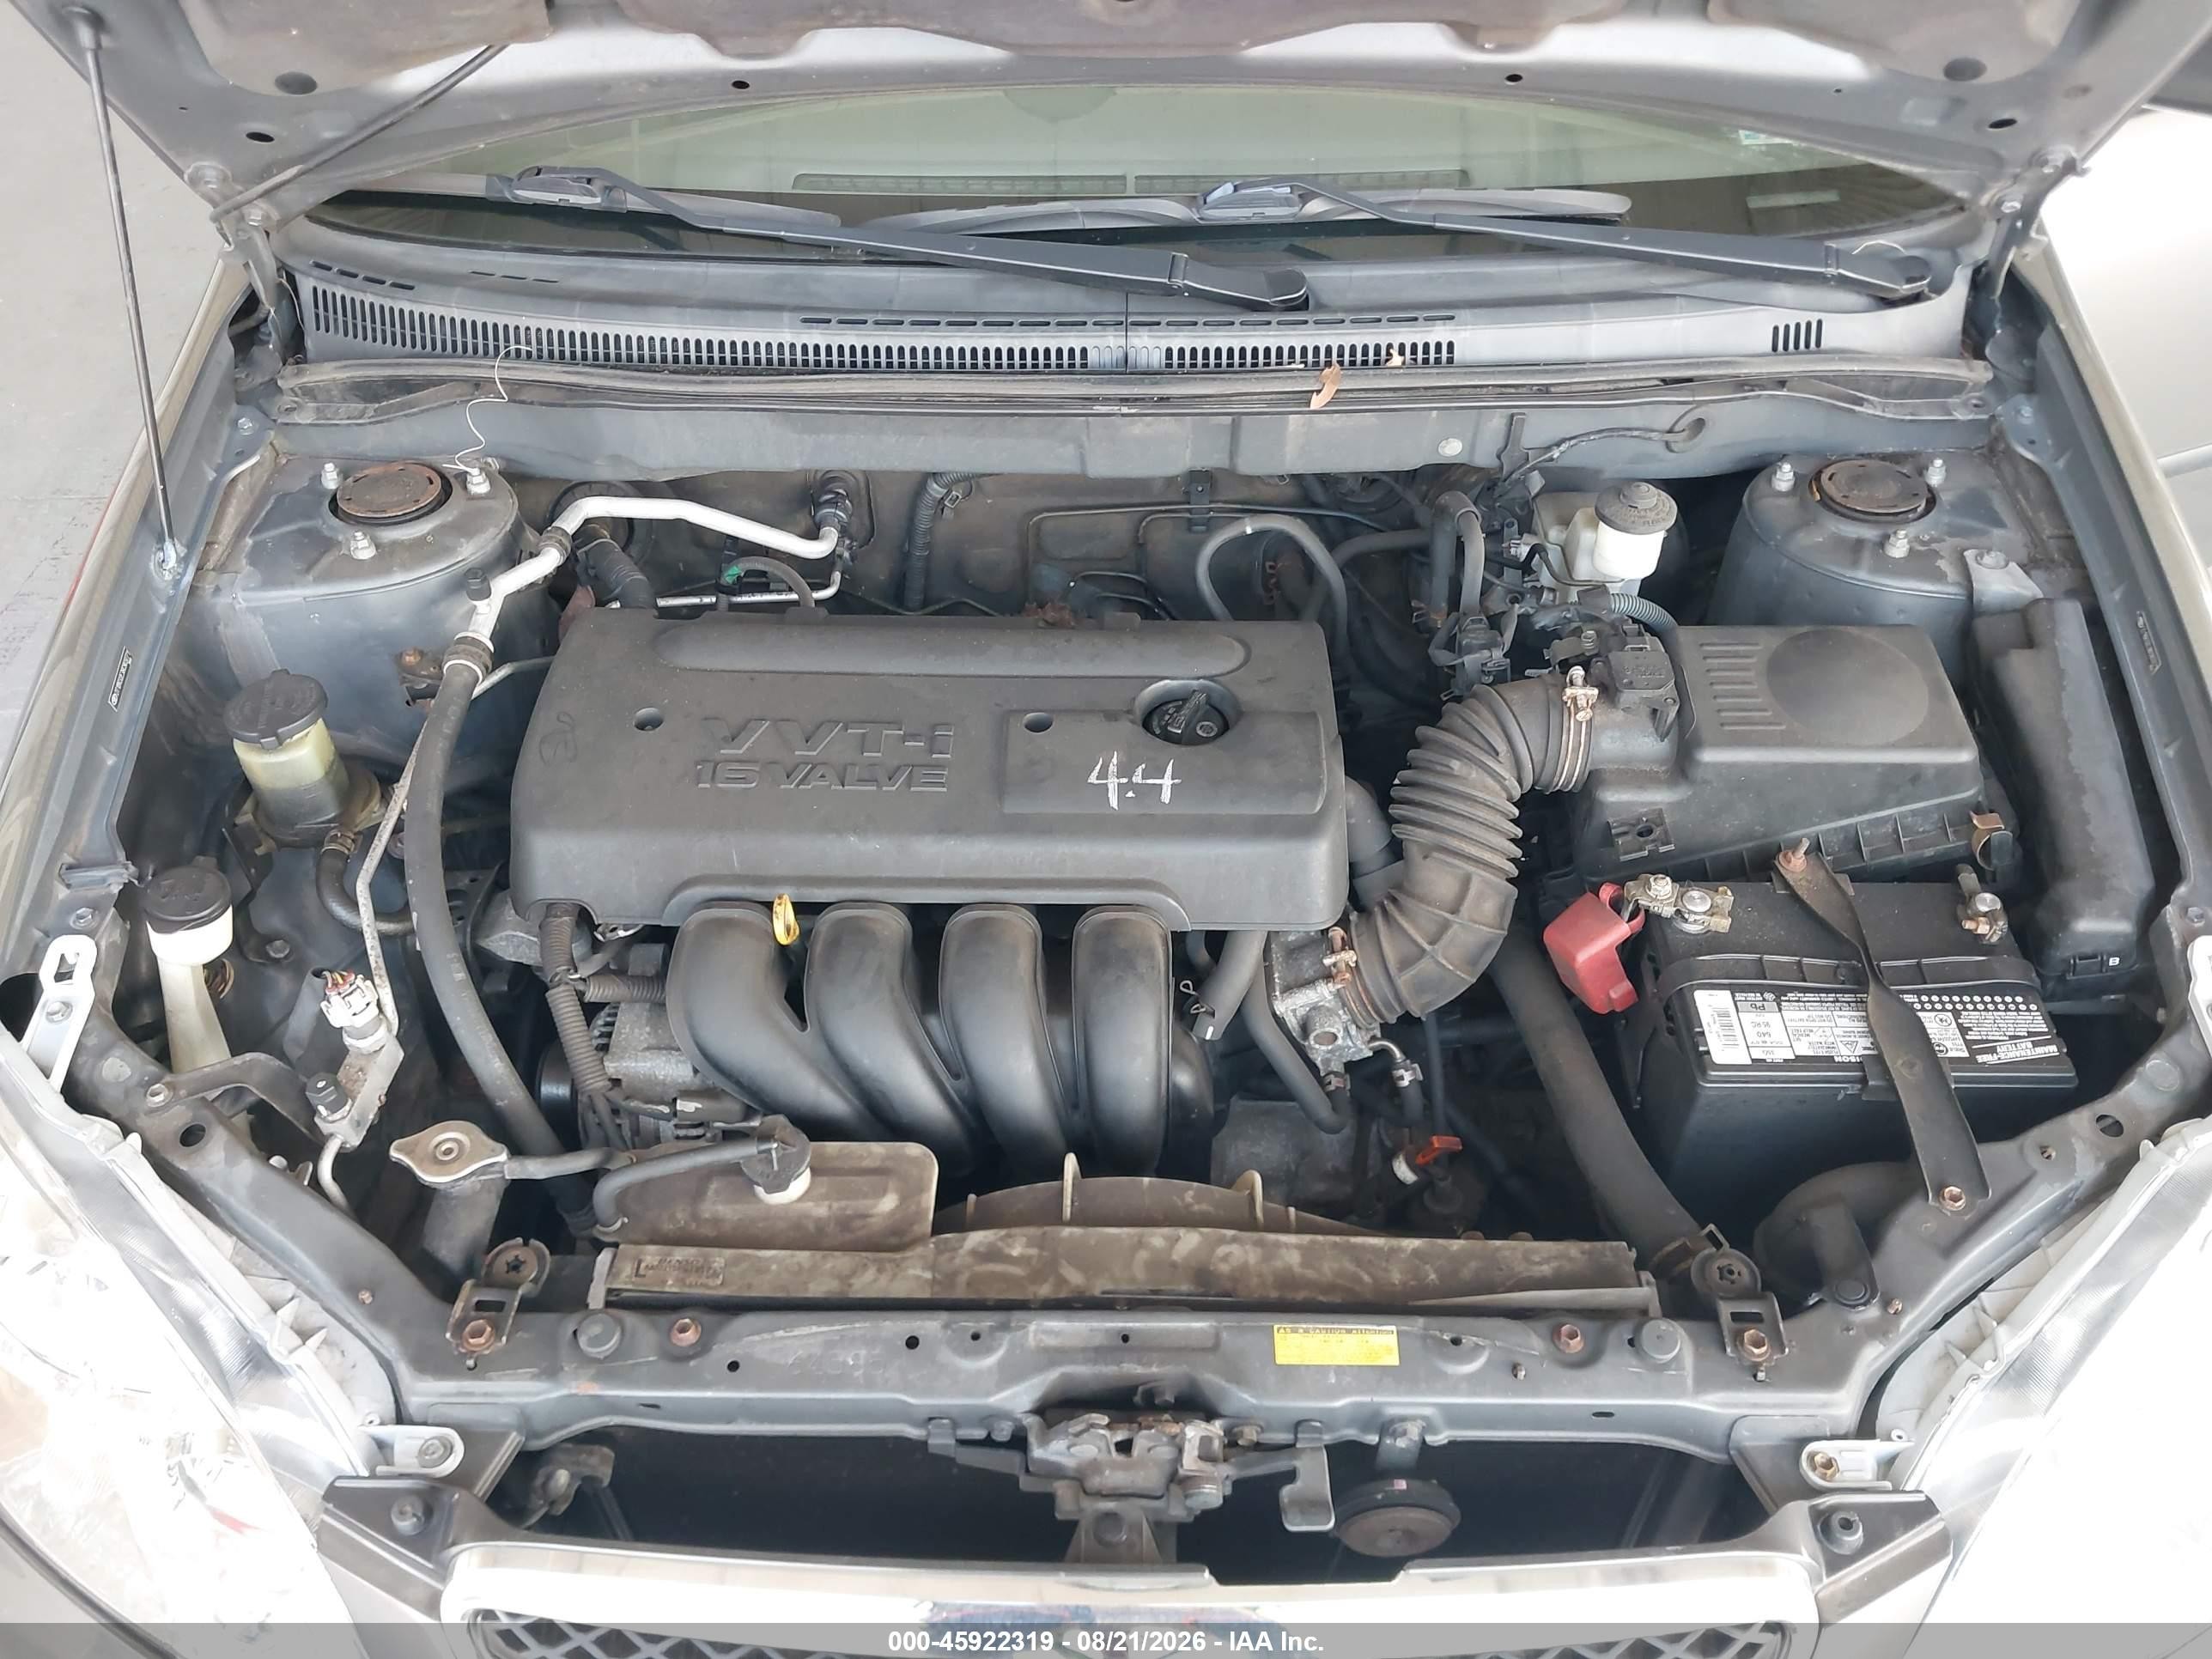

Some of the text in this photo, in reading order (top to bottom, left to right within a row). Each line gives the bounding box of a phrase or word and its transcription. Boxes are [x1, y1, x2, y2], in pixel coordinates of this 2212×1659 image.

[695, 759, 949, 793] 16 VALVE
[1086, 750, 1182, 811] 4.4
[2108, 957, 2121, 967] B
[1976, 1044, 2058, 1063] MAINTENANCE-FREE
[1996, 1041, 2033, 1054] BATTERY
